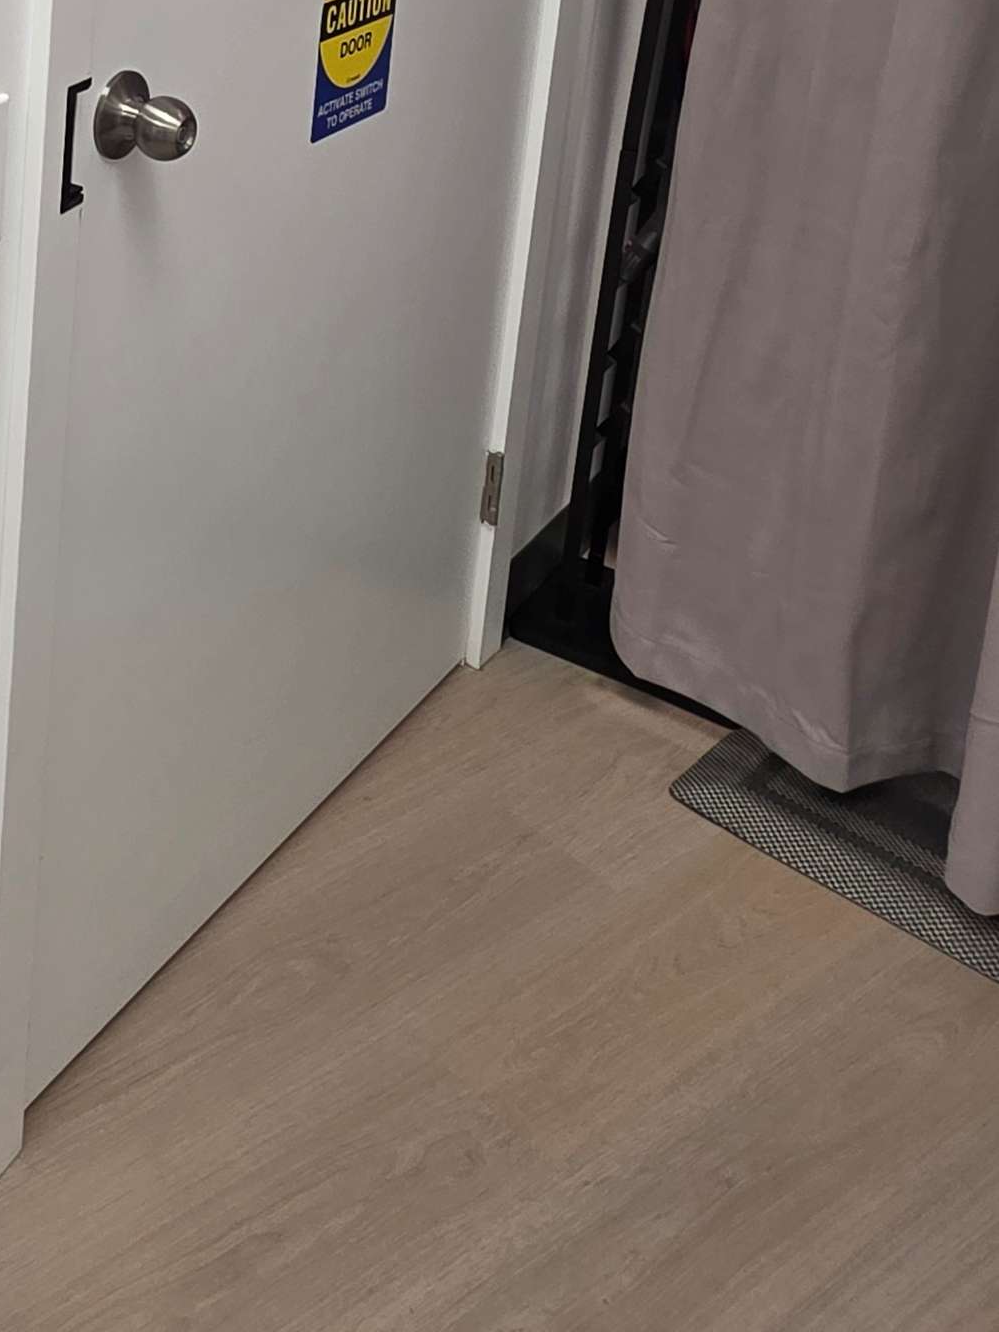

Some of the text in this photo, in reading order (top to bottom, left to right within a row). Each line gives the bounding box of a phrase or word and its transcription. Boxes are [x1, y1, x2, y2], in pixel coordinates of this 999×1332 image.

[340, 31, 373, 59] DOOR
[317, 91, 354, 118] ACTIVATE
[327, 98, 373, 129] TO OPERATE
